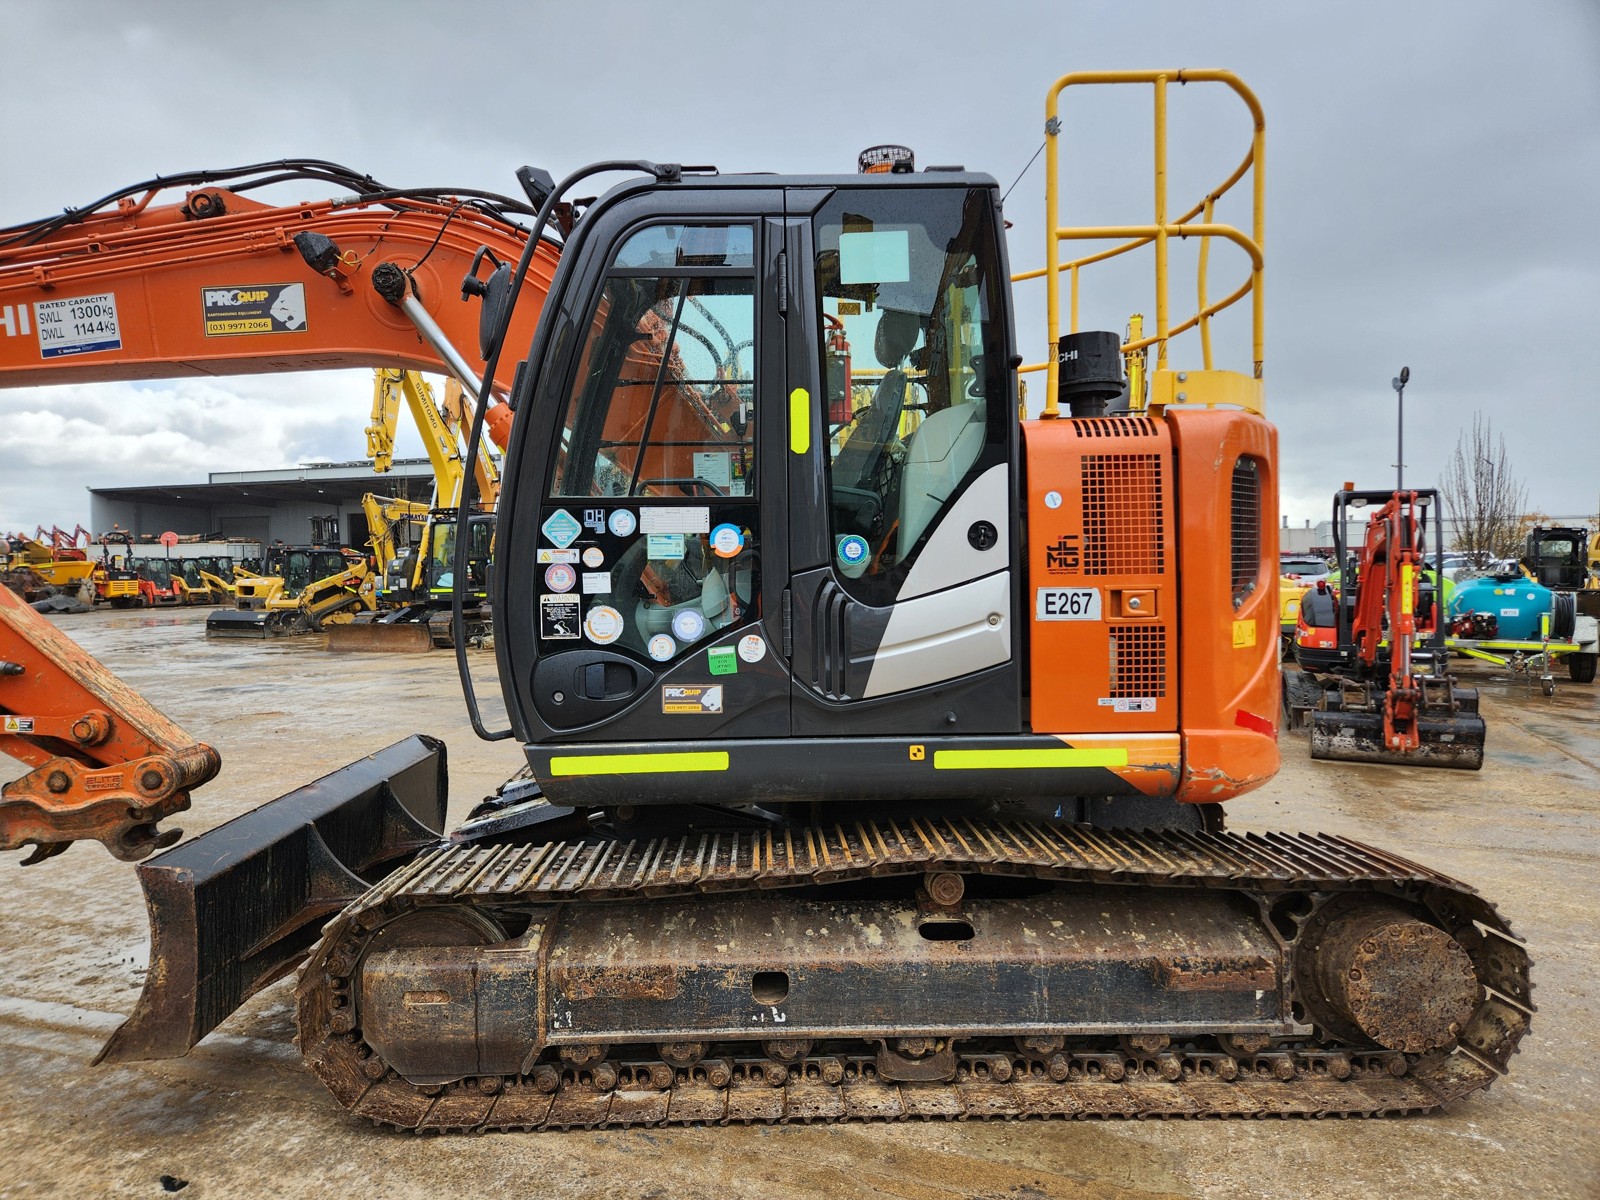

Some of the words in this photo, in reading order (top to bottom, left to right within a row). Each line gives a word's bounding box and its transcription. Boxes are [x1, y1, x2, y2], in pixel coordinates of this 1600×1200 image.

[40, 301, 66, 310] RATED
[69, 296, 108, 306] CAPACITY
[39, 311, 63, 324] SWLL
[228, 322, 246, 330] 9971
[249, 321, 269, 329] 2066
[42, 327, 65, 340] DWLL
[415, 383, 438, 429] SUMITOMO
[400, 512, 429, 520] KOMATSU
[552, 594, 579, 602] WARNING
[1045, 592, 1093, 615] E267
[86, 775, 121, 784] ELITE
